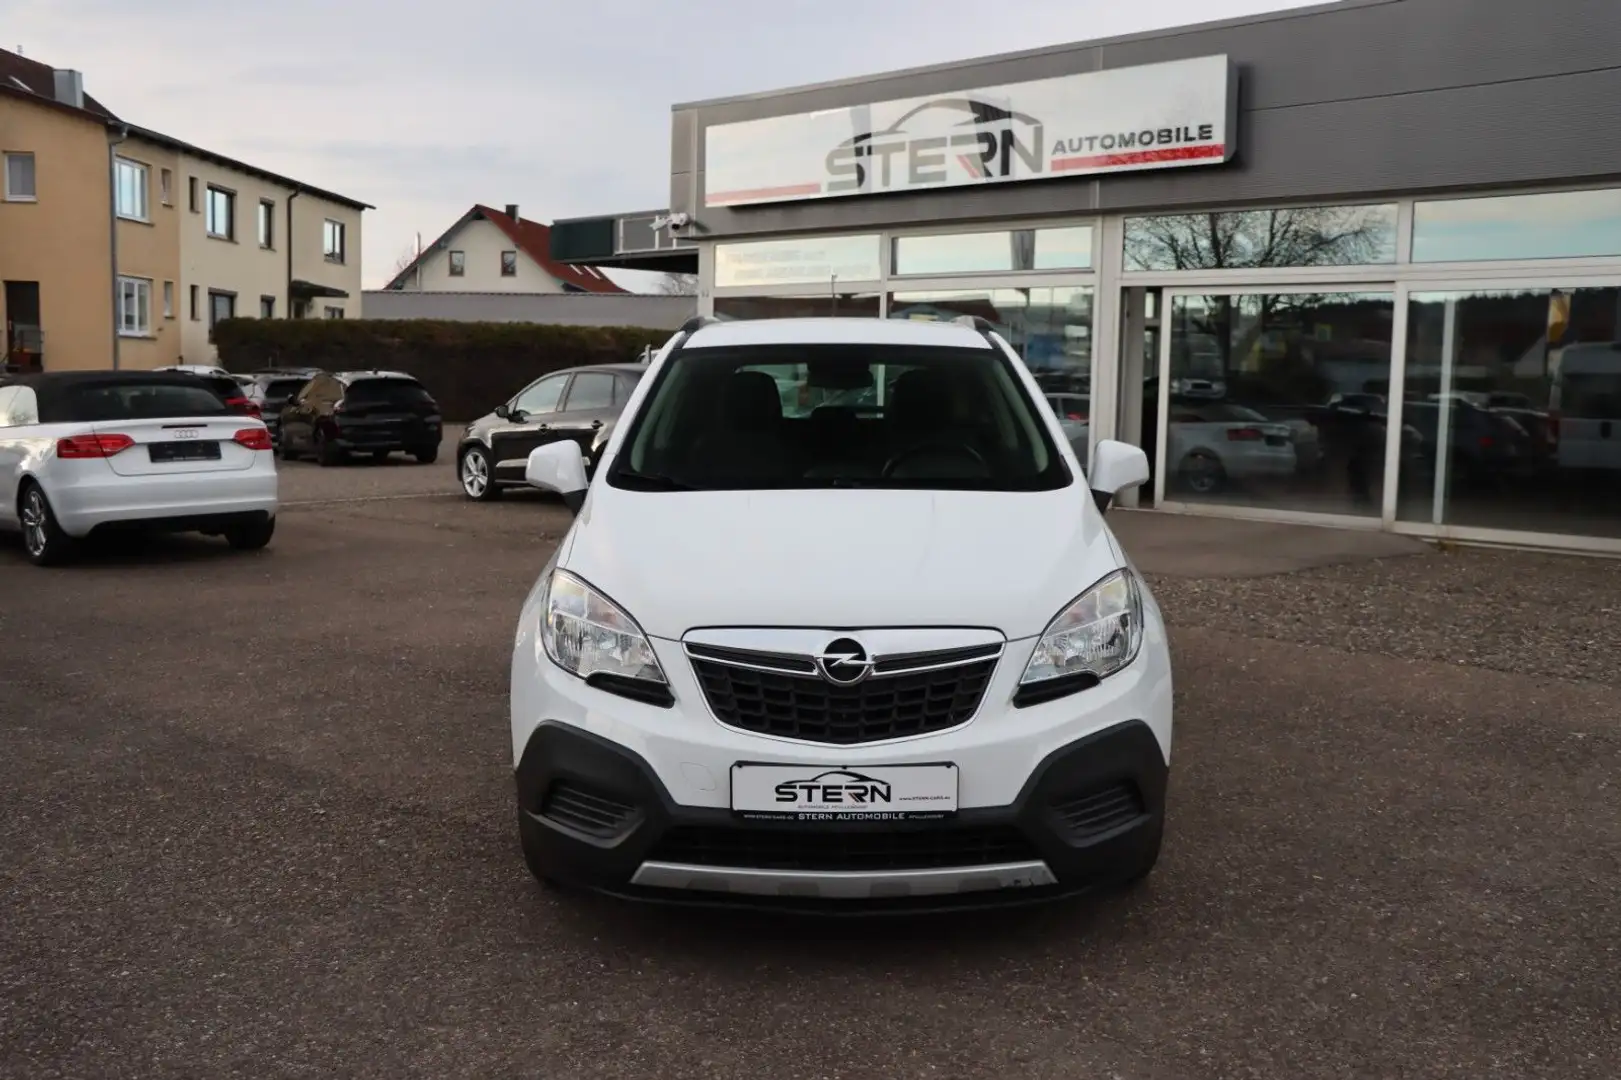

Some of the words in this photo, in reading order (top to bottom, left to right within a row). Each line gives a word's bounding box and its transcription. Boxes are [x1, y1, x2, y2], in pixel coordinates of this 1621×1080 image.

[825, 125, 1044, 191] STERN
[1051, 124, 1213, 155] AUTOMOBILE
[775, 784, 891, 802] STERN
[837, 812, 905, 820] AUTOMOBILE
